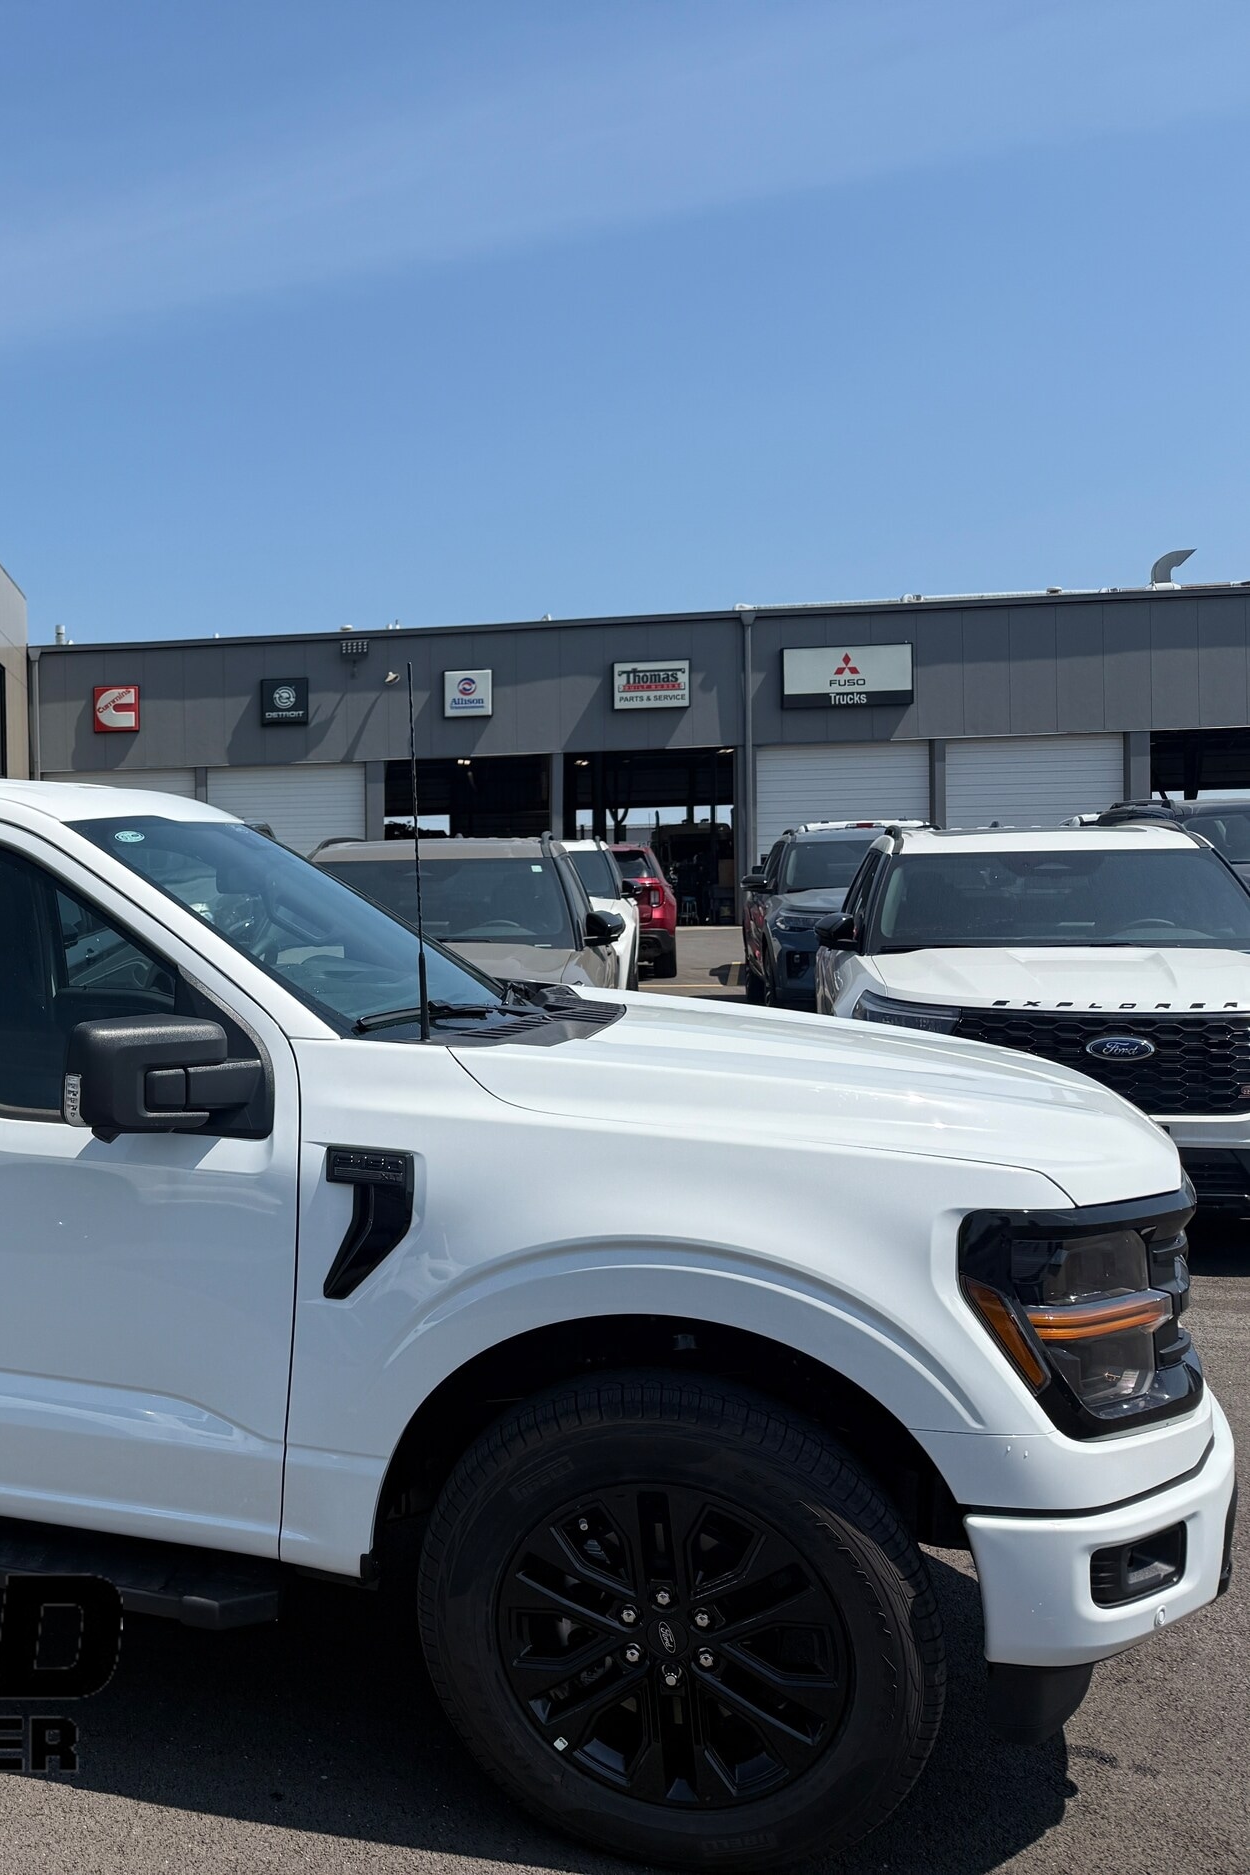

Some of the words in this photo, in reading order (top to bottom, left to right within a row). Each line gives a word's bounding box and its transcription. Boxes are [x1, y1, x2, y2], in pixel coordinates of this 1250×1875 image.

[618, 667, 685, 684] Thomas
[829, 678, 866, 687] FUSO
[97, 689, 131, 713] Cummins
[451, 698, 484, 706] Allison
[829, 692, 867, 705] Trucks
[265, 710, 305, 719] DETROIT
[992, 1000, 1238, 1009] EXPLORER
[1102, 1041, 1139, 1056] Ford
